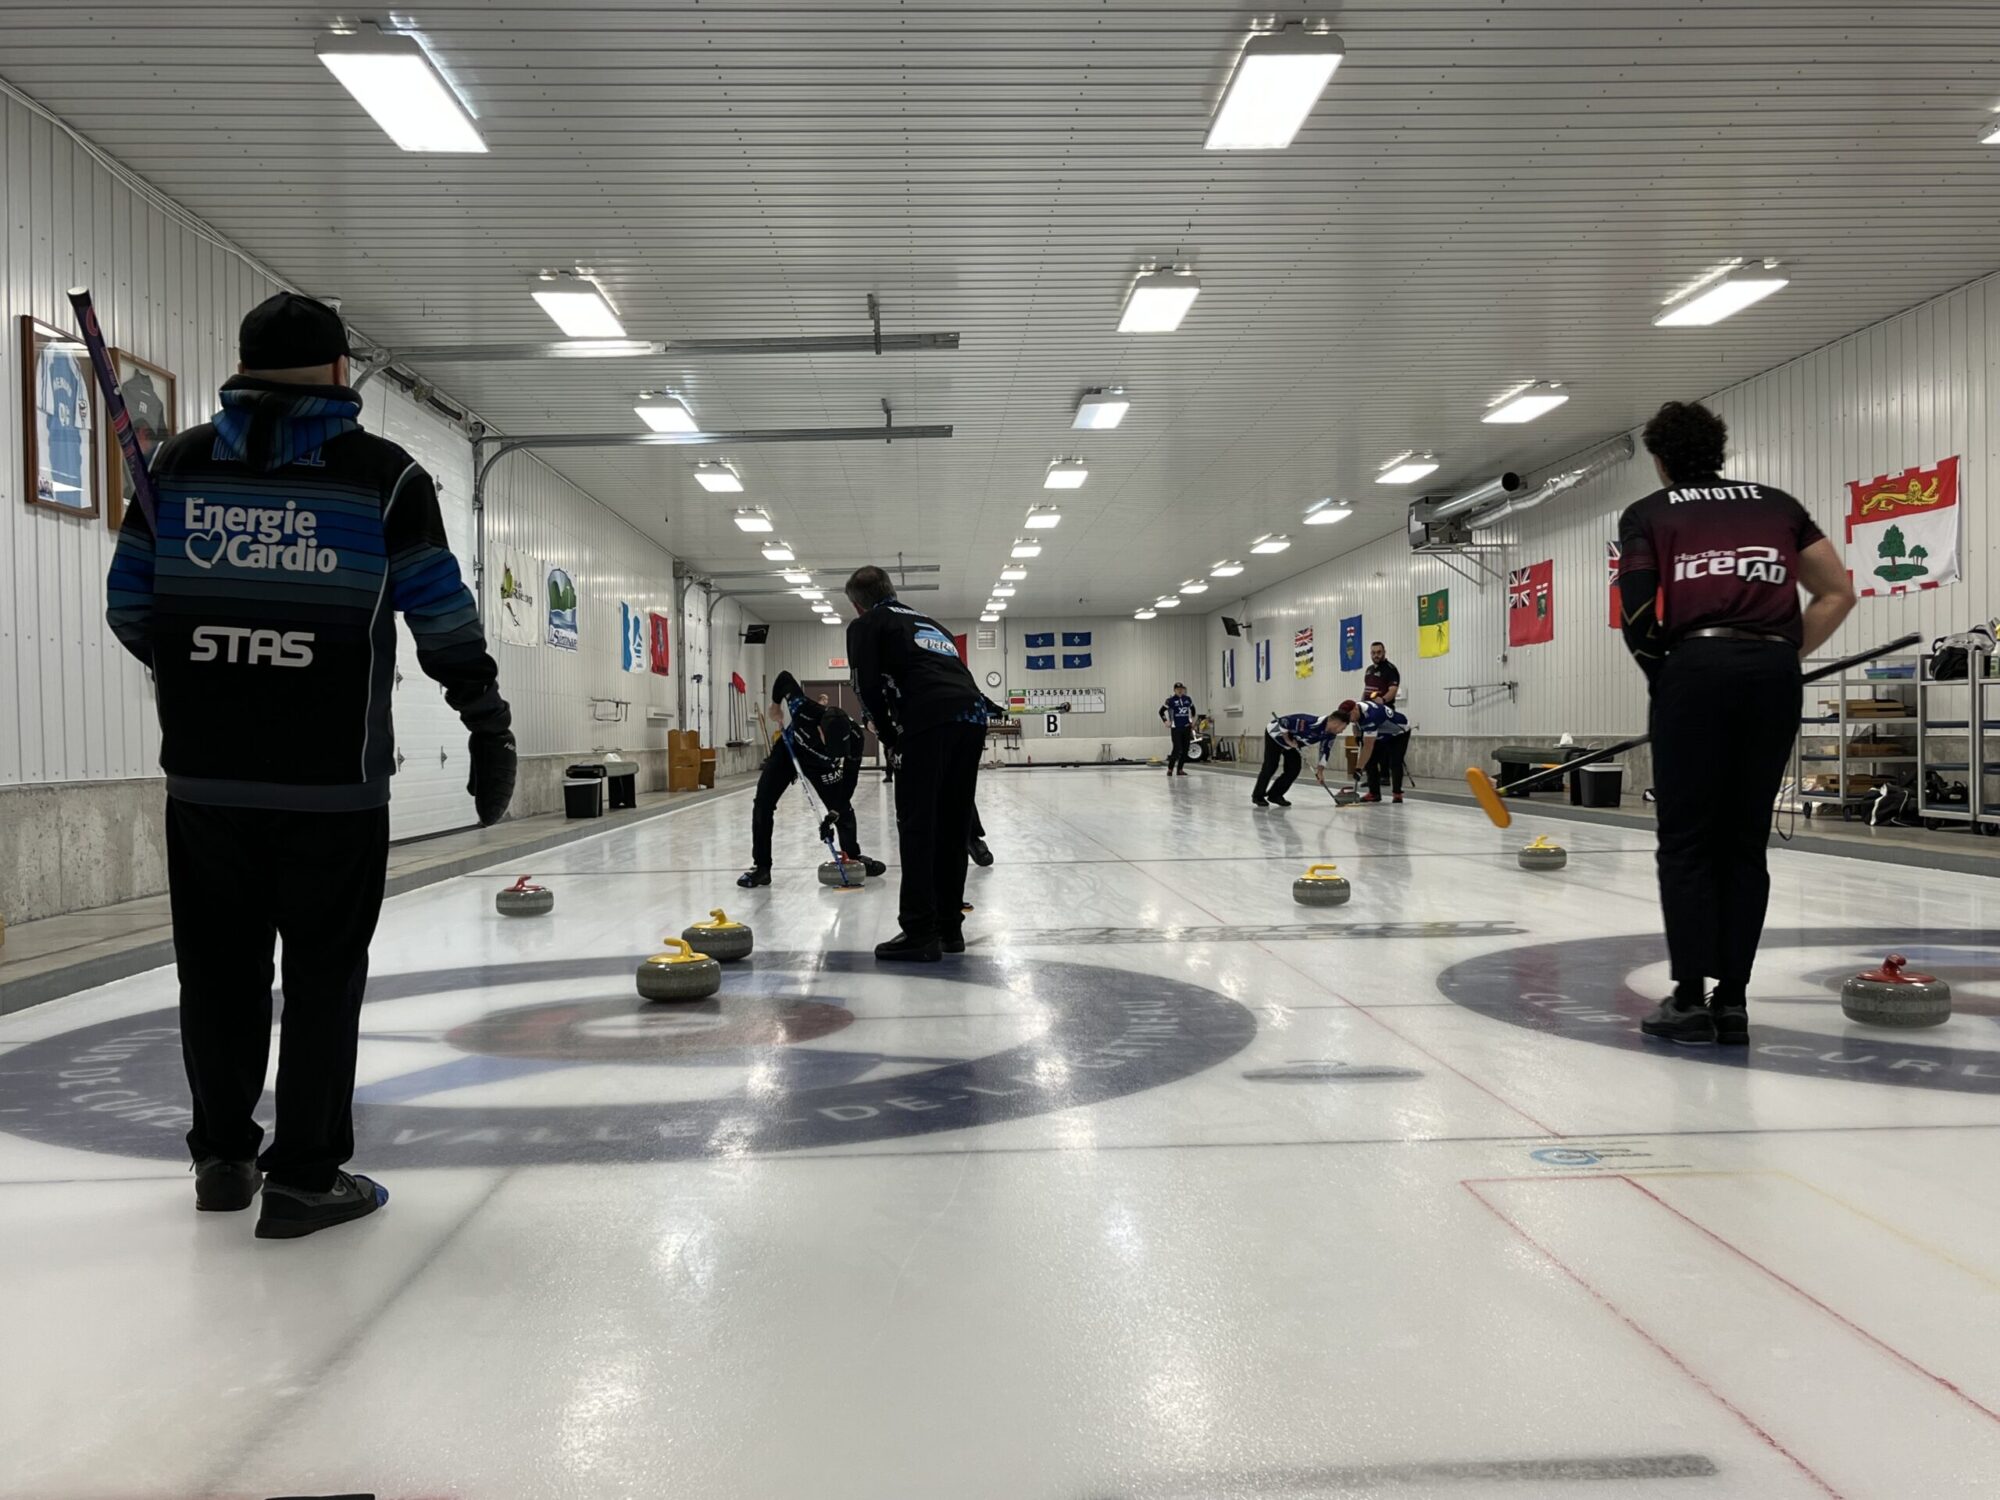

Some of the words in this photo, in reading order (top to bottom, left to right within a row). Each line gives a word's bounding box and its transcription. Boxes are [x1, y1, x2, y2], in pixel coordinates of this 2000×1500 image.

[1668, 485, 1763, 504] AMYOTTE
[227, 534, 338, 573] Cardio
[1674, 550, 1736, 563] Hardline
[190, 625, 315, 667] STAS
[1046, 714, 1058, 733] B
[1520, 992, 1631, 1022] CLUB
[1756, 1044, 2000, 1079] CURL
